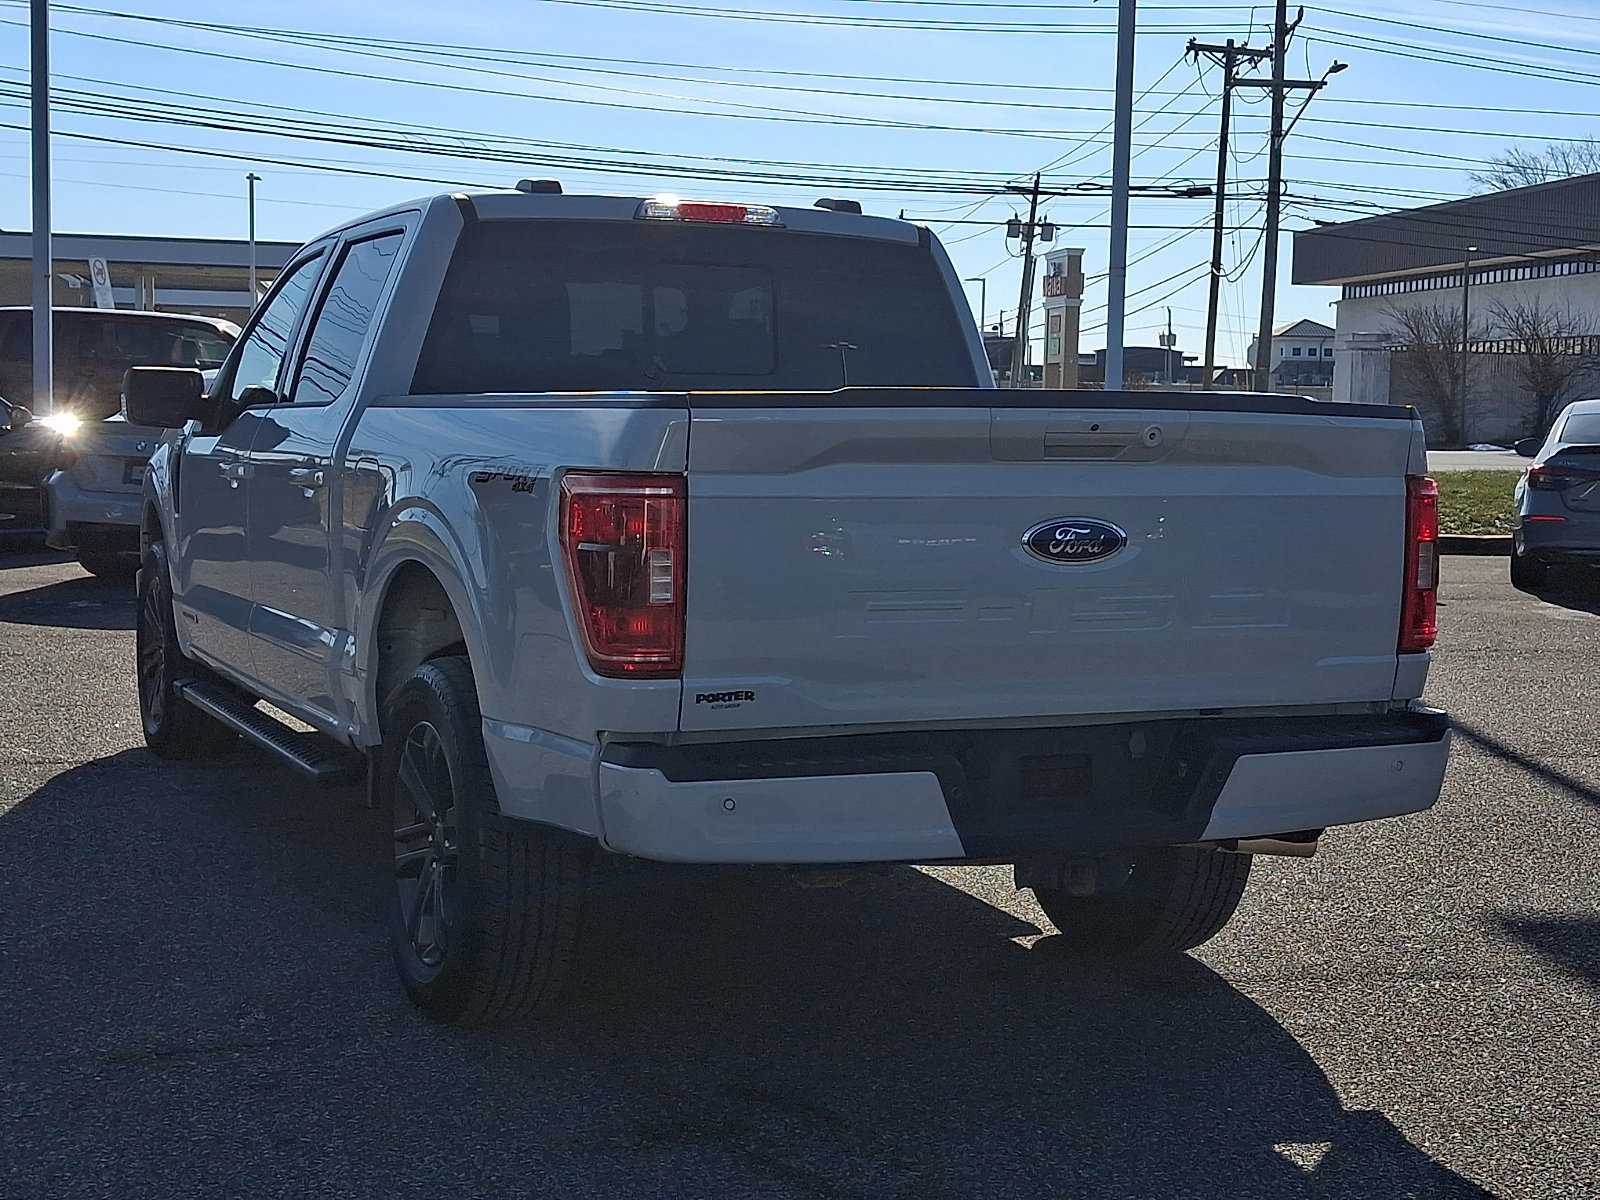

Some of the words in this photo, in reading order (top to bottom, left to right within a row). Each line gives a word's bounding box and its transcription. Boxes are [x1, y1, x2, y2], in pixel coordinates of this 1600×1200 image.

[475, 464, 547, 483] SPORT
[1049, 526, 1105, 554] Ford
[695, 690, 756, 704] PORTER
